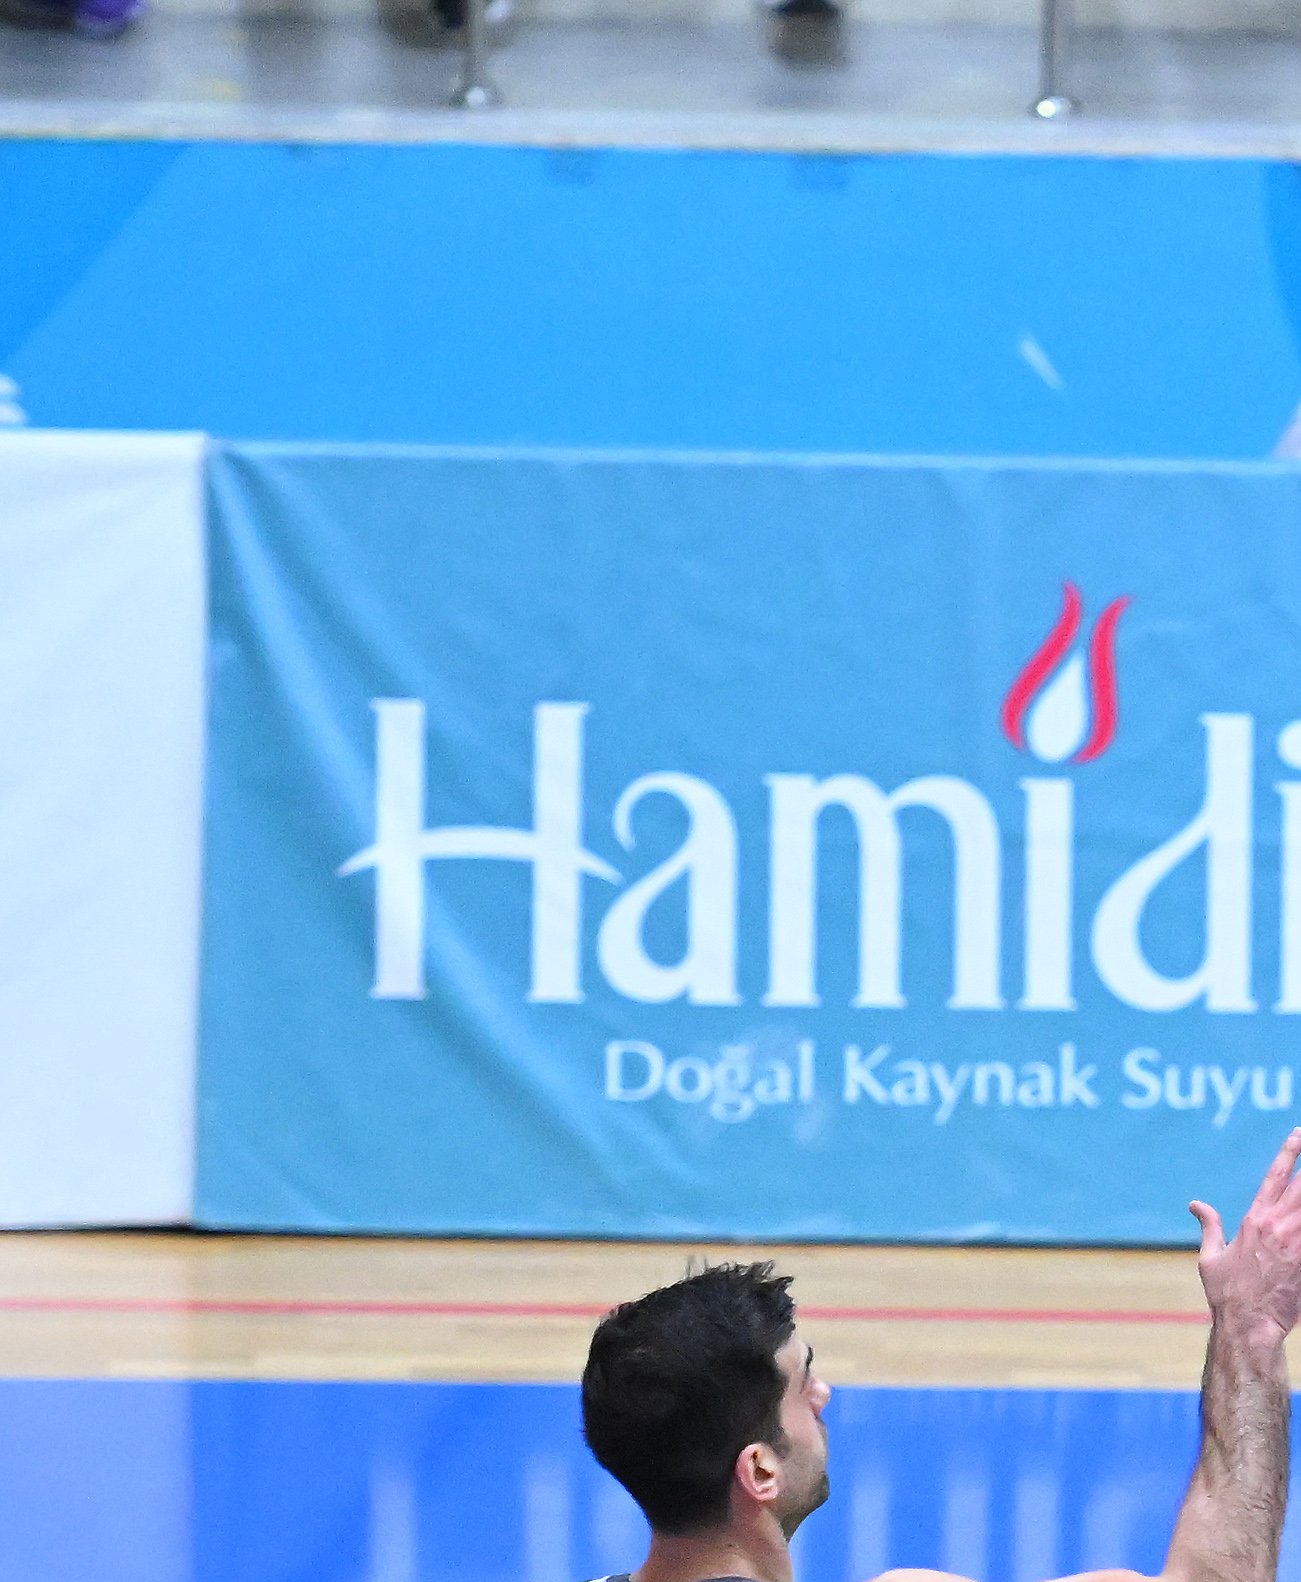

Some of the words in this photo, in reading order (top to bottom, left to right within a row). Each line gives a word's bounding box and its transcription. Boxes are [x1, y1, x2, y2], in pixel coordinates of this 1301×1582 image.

[603, 1039, 815, 1123] Doğal
[842, 1041, 1099, 1126] Kaynak
[1121, 1046, 1294, 1128] Suyu
